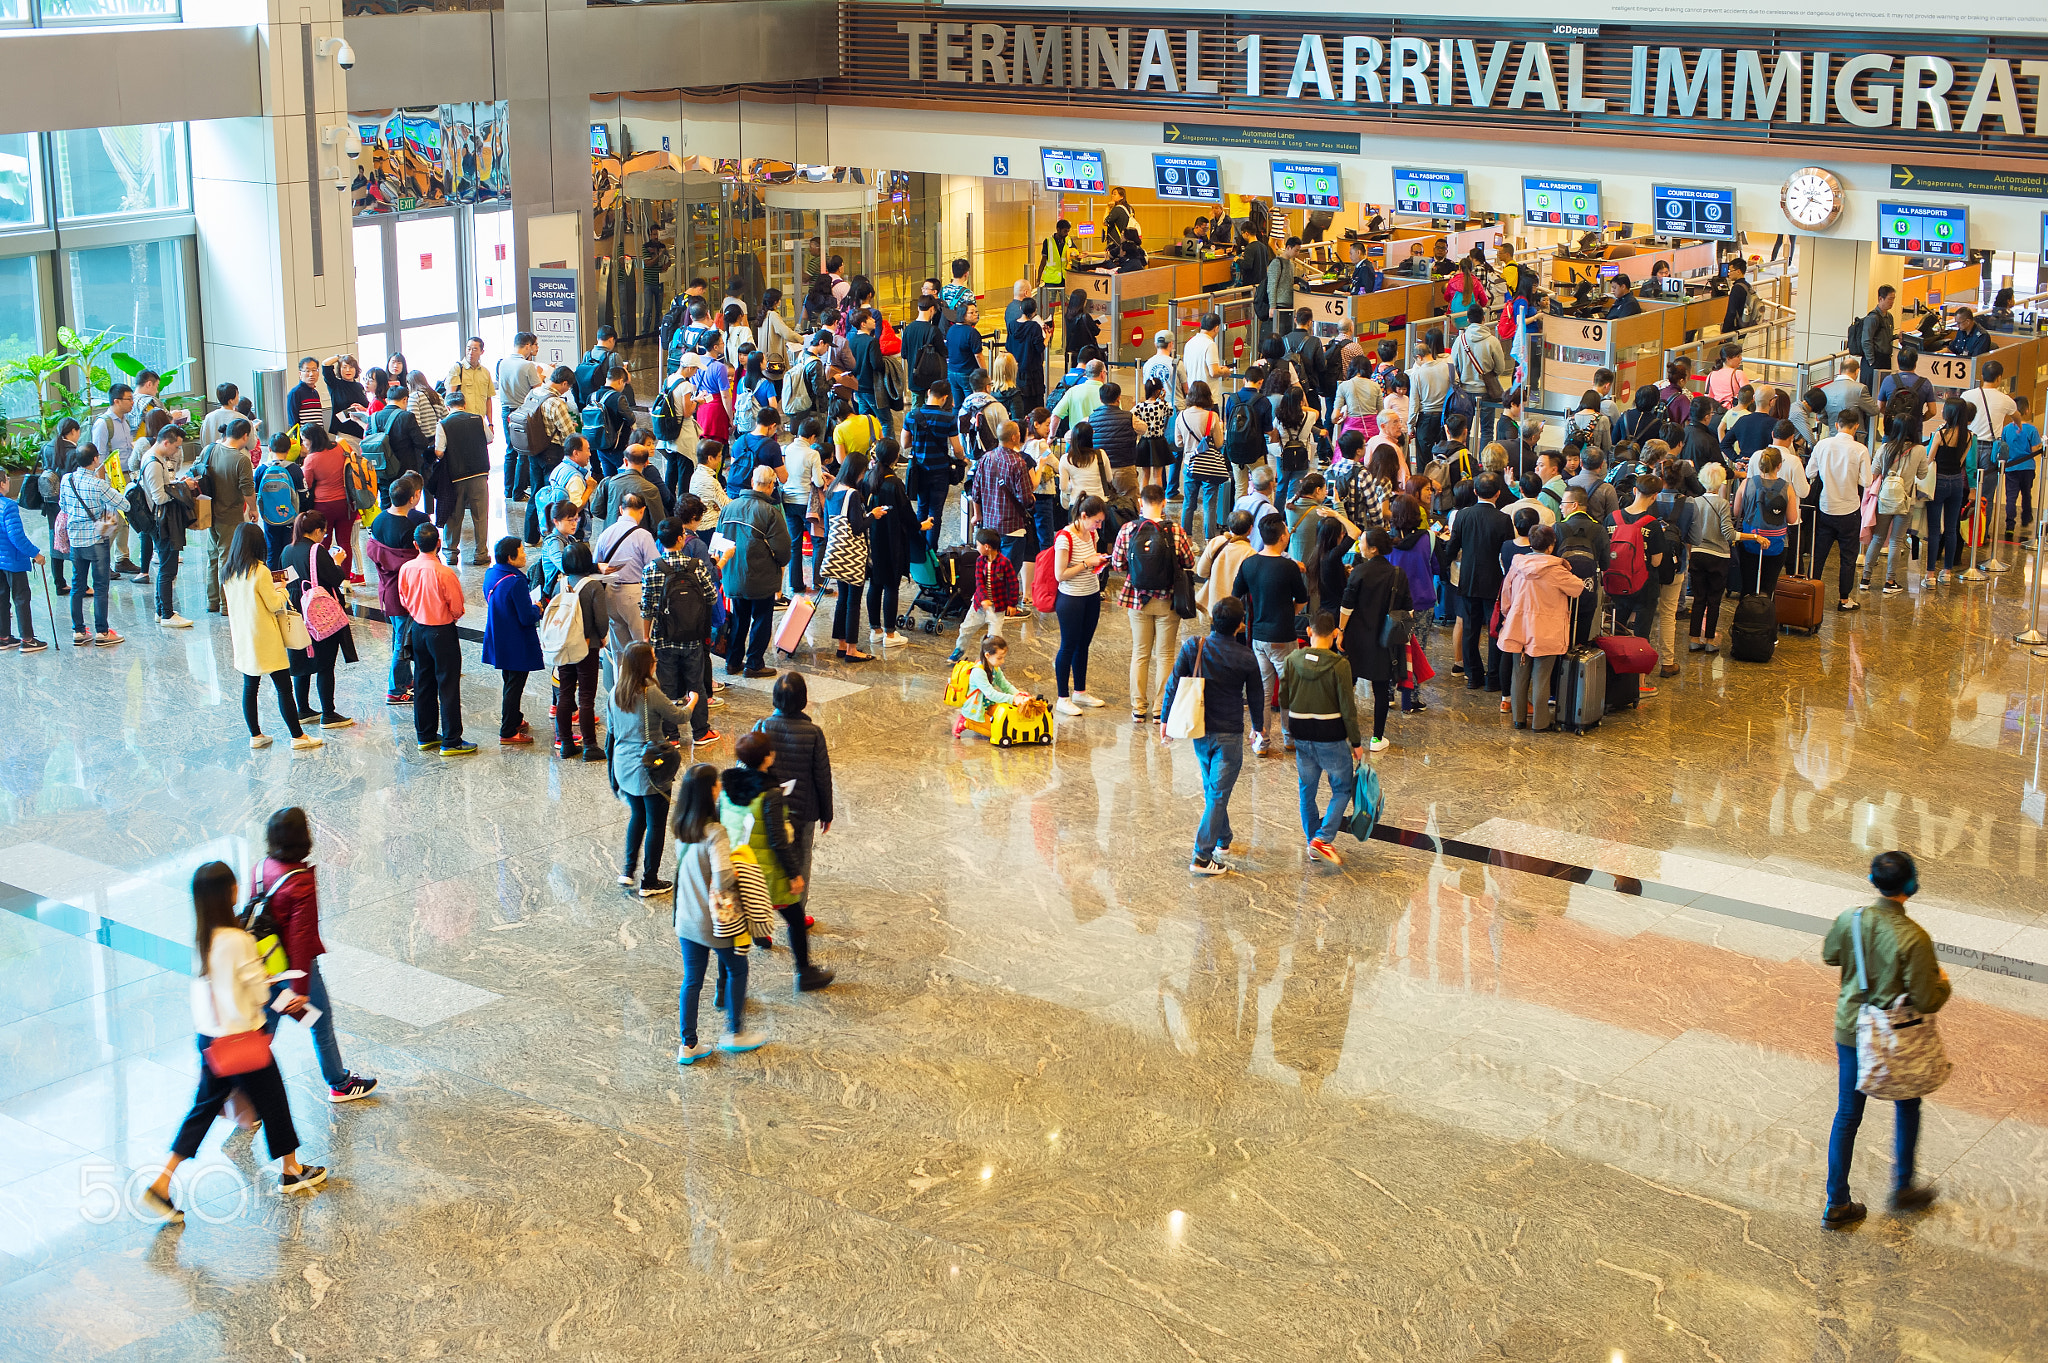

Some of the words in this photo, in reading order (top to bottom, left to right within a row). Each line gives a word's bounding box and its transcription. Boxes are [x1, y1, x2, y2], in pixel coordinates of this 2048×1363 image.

[1553, 25, 1598, 34] JCDecaux
[897, 22, 1220, 94] TERMINAL
[1237, 34, 1261, 96] 1
[1286, 34, 1606, 113] ARRIVAL
[1630, 45, 2048, 136] IMMIGRAT
[1182, 134, 1219, 142] Singaporeans,
[1242, 130, 1276, 138] Automated
[1168, 171, 1175, 179] 03
[1994, 174, 2040, 185] Automated
[1286, 179, 1293, 187] 05
[1318, 181, 1326, 189] 06
[1917, 179, 1964, 188] Singaporeans,
[1409, 186, 1416, 194] 07
[1444, 188, 1451, 197] 08
[400, 199, 414, 209] EXIT
[1540, 196, 1547, 205] 09
[1576, 199, 1583, 208] 10
[1671, 205, 1677, 213] 11
[1710, 207, 1716, 216] 12
[1897, 222, 1906, 232] 13
[1940, 225, 1948, 235] 14
[1186, 240, 1193, 252] 2
[1418, 260, 1426, 271] 6
[1927, 258, 1940, 268] 12
[1102, 279, 1108, 294] 1
[1666, 279, 1679, 292] 10
[1334, 300, 1344, 315] 5
[2018, 312, 2032, 325] 14
[1592, 325, 1602, 341] 9
[1943, 361, 1966, 379] 13
